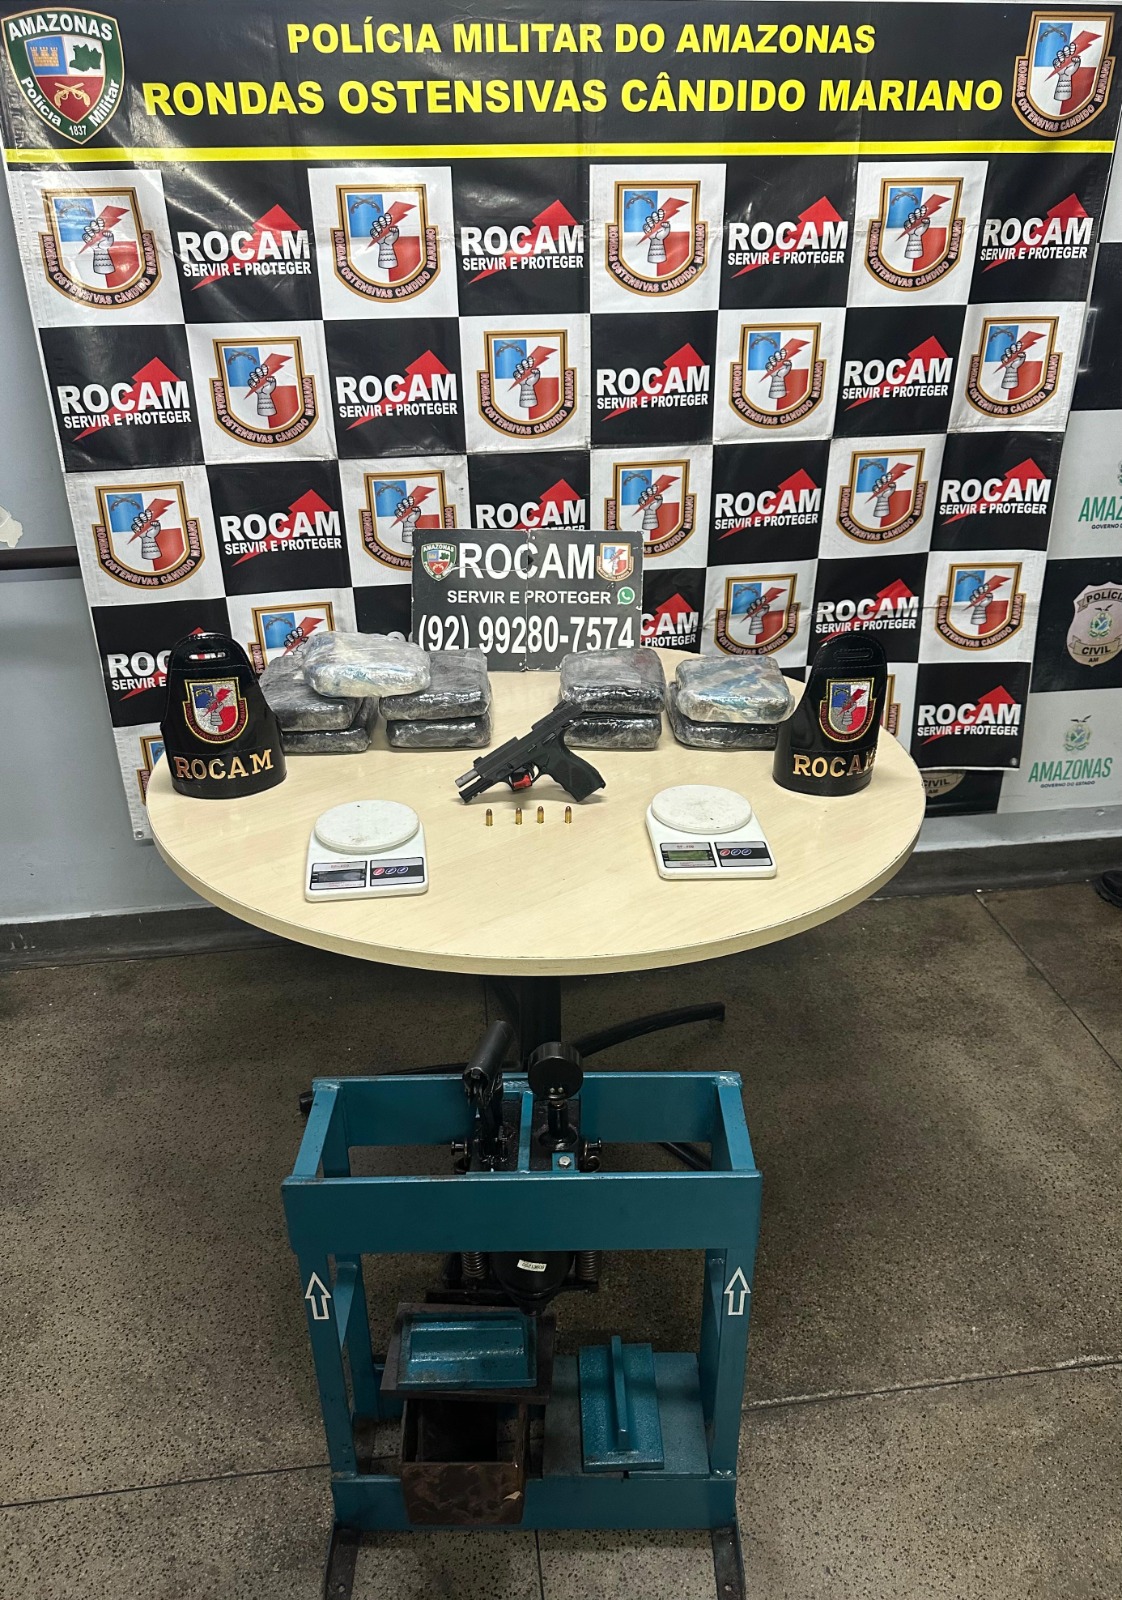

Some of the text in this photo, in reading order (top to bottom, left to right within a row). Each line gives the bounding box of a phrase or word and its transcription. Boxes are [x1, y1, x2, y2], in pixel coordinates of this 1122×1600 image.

[8, 13, 112, 41] AMAZONAS
[288, 17, 875, 54] POLÍCIA MILITAR DO AMAZONAS
[21, 77, 61, 127] Polícia
[89, 80, 120, 128] Militar
[142, 72, 1003, 116] RONDAS OSTENSIVAS CÂNDIDO MARIANO
[69, 125, 86, 136] 1837
[178, 229, 310, 261] ROCAM
[461, 225, 584, 255] ROCAM
[728, 220, 848, 250] ROCAM
[982, 217, 1094, 247] ROCAM
[462, 256, 584, 271] SERVIR E PROTEGER
[728, 251, 844, 265] SERVIR E PROTEGER
[980, 246, 1087, 261] SERVIR E PROTEGER
[183, 261, 311, 277] SERVIR E PROTEGER
[611, 263, 659, 293] OSTENSIVAS
[341, 267, 393, 299] OSTENSIVAS
[596, 365, 710, 396] ROCAM
[843, 358, 953, 387] ROCAM
[57, 380, 190, 415] ROCAM
[335, 373, 457, 404] ROCAM
[596, 394, 708, 410] SERVIR E PROTEGER
[842, 384, 948, 399] SERVIR E PROTEGER
[64, 411, 191, 429] SERVIR E PROTEGER
[339, 402, 458, 418] SERVIR E PROTEGER
[485, 407, 531, 435] OSTENSIVAS
[221, 415, 273, 444] OSTENSIVAS
[715, 488, 822, 518] ROCAM
[940, 478, 1051, 503] ROCAM
[475, 499, 586, 529] ROCAM
[715, 513, 818, 530] SERVIR E PROTEGER
[939, 503, 1047, 515] SERVIR E PROTEGER
[220, 511, 341, 542] ROCAM
[225, 538, 342, 555] SERVIR E PROTEGER
[368, 541, 411, 567] OSTENSIVA
[459, 543, 595, 580] ROCAM
[447, 590, 611, 605] SERVIR E PROTEGER
[816, 596, 919, 623] ROCAM
[1087, 590, 1122, 602] POLÍCI
[419, 614, 635, 654] (92) 99280-7574
[640, 611, 698, 635] CAM
[816, 619, 916, 633] SERVIR E PROTEGER
[645, 634, 696, 647] PROTEGER
[1082, 646, 1111, 655] CIVIL
[107, 650, 171, 679] ROC
[112, 678, 166, 691] SERVIR E
[918, 703, 1022, 726] ROCAM
[917, 726, 1018, 737] SERVIR E PROTEGER
[173, 749, 274, 779] ROCAM
[1028, 757, 1113, 782] AMAZONAS
